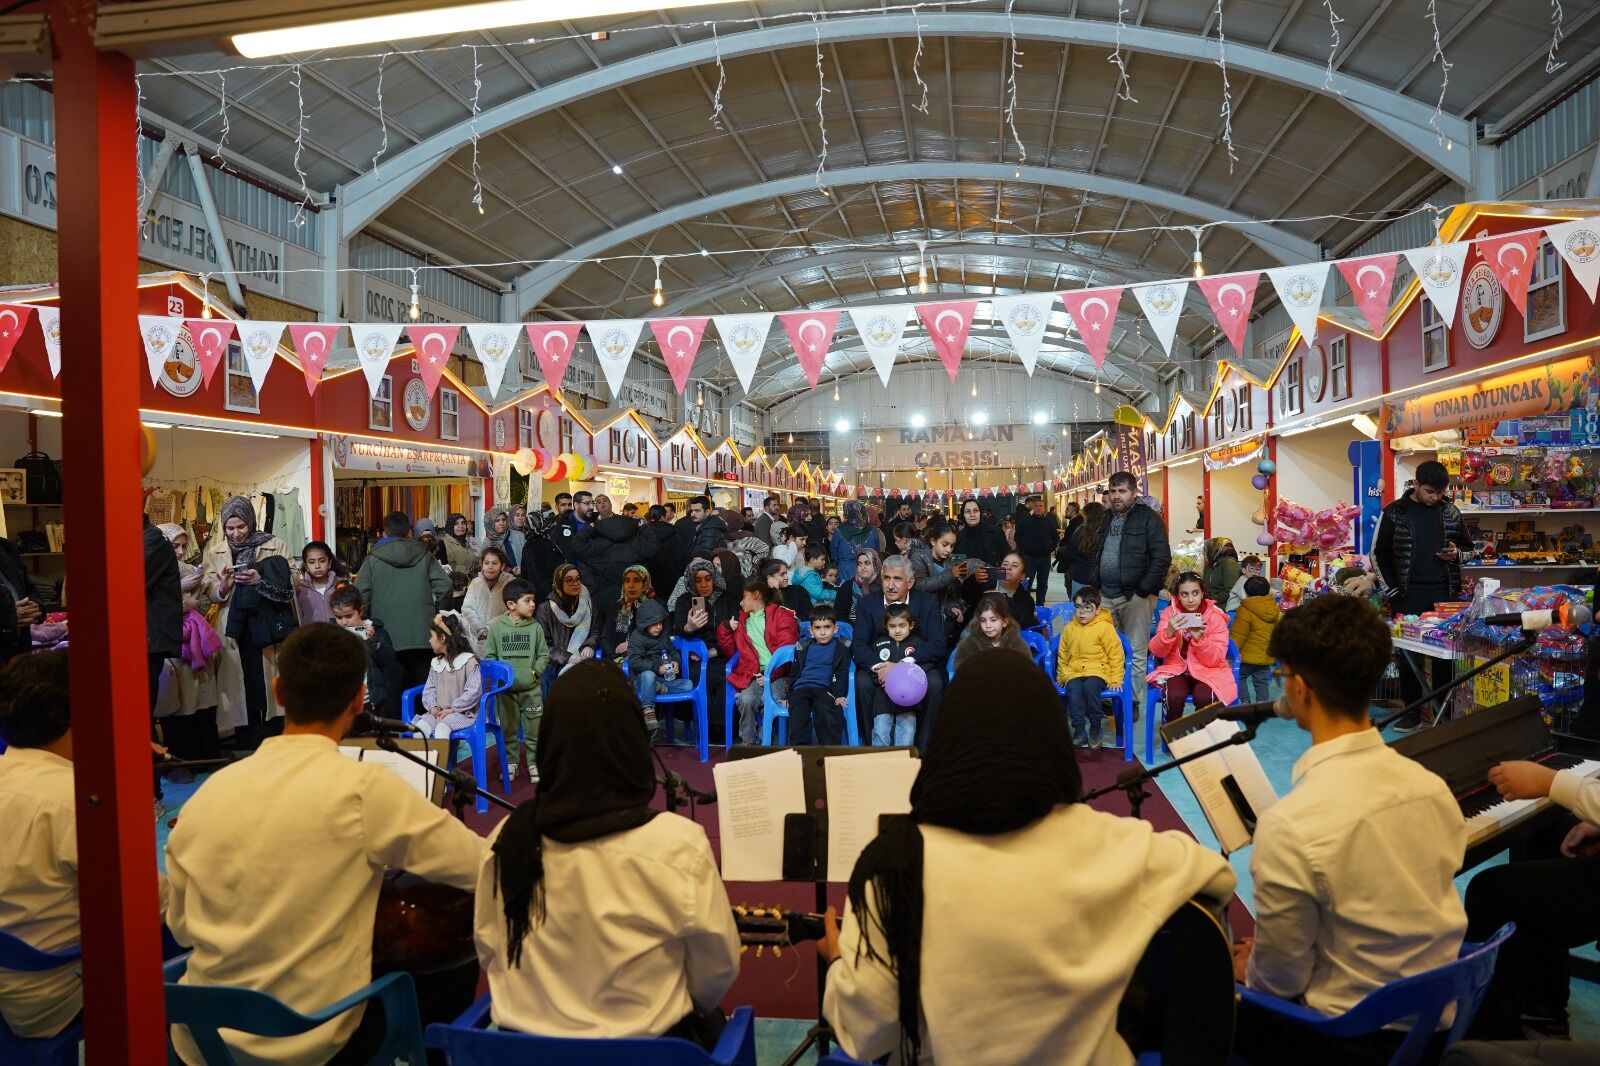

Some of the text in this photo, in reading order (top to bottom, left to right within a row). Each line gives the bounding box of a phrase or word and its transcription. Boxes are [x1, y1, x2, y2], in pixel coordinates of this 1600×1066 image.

[169, 299, 182, 314] 23
[1433, 378, 1544, 423] ÇINAR OYUNCAK
[350, 440, 466, 466] NURCİHAN EŞARP&ÇANTA
[502, 634, 531, 643] NO LIMITS
